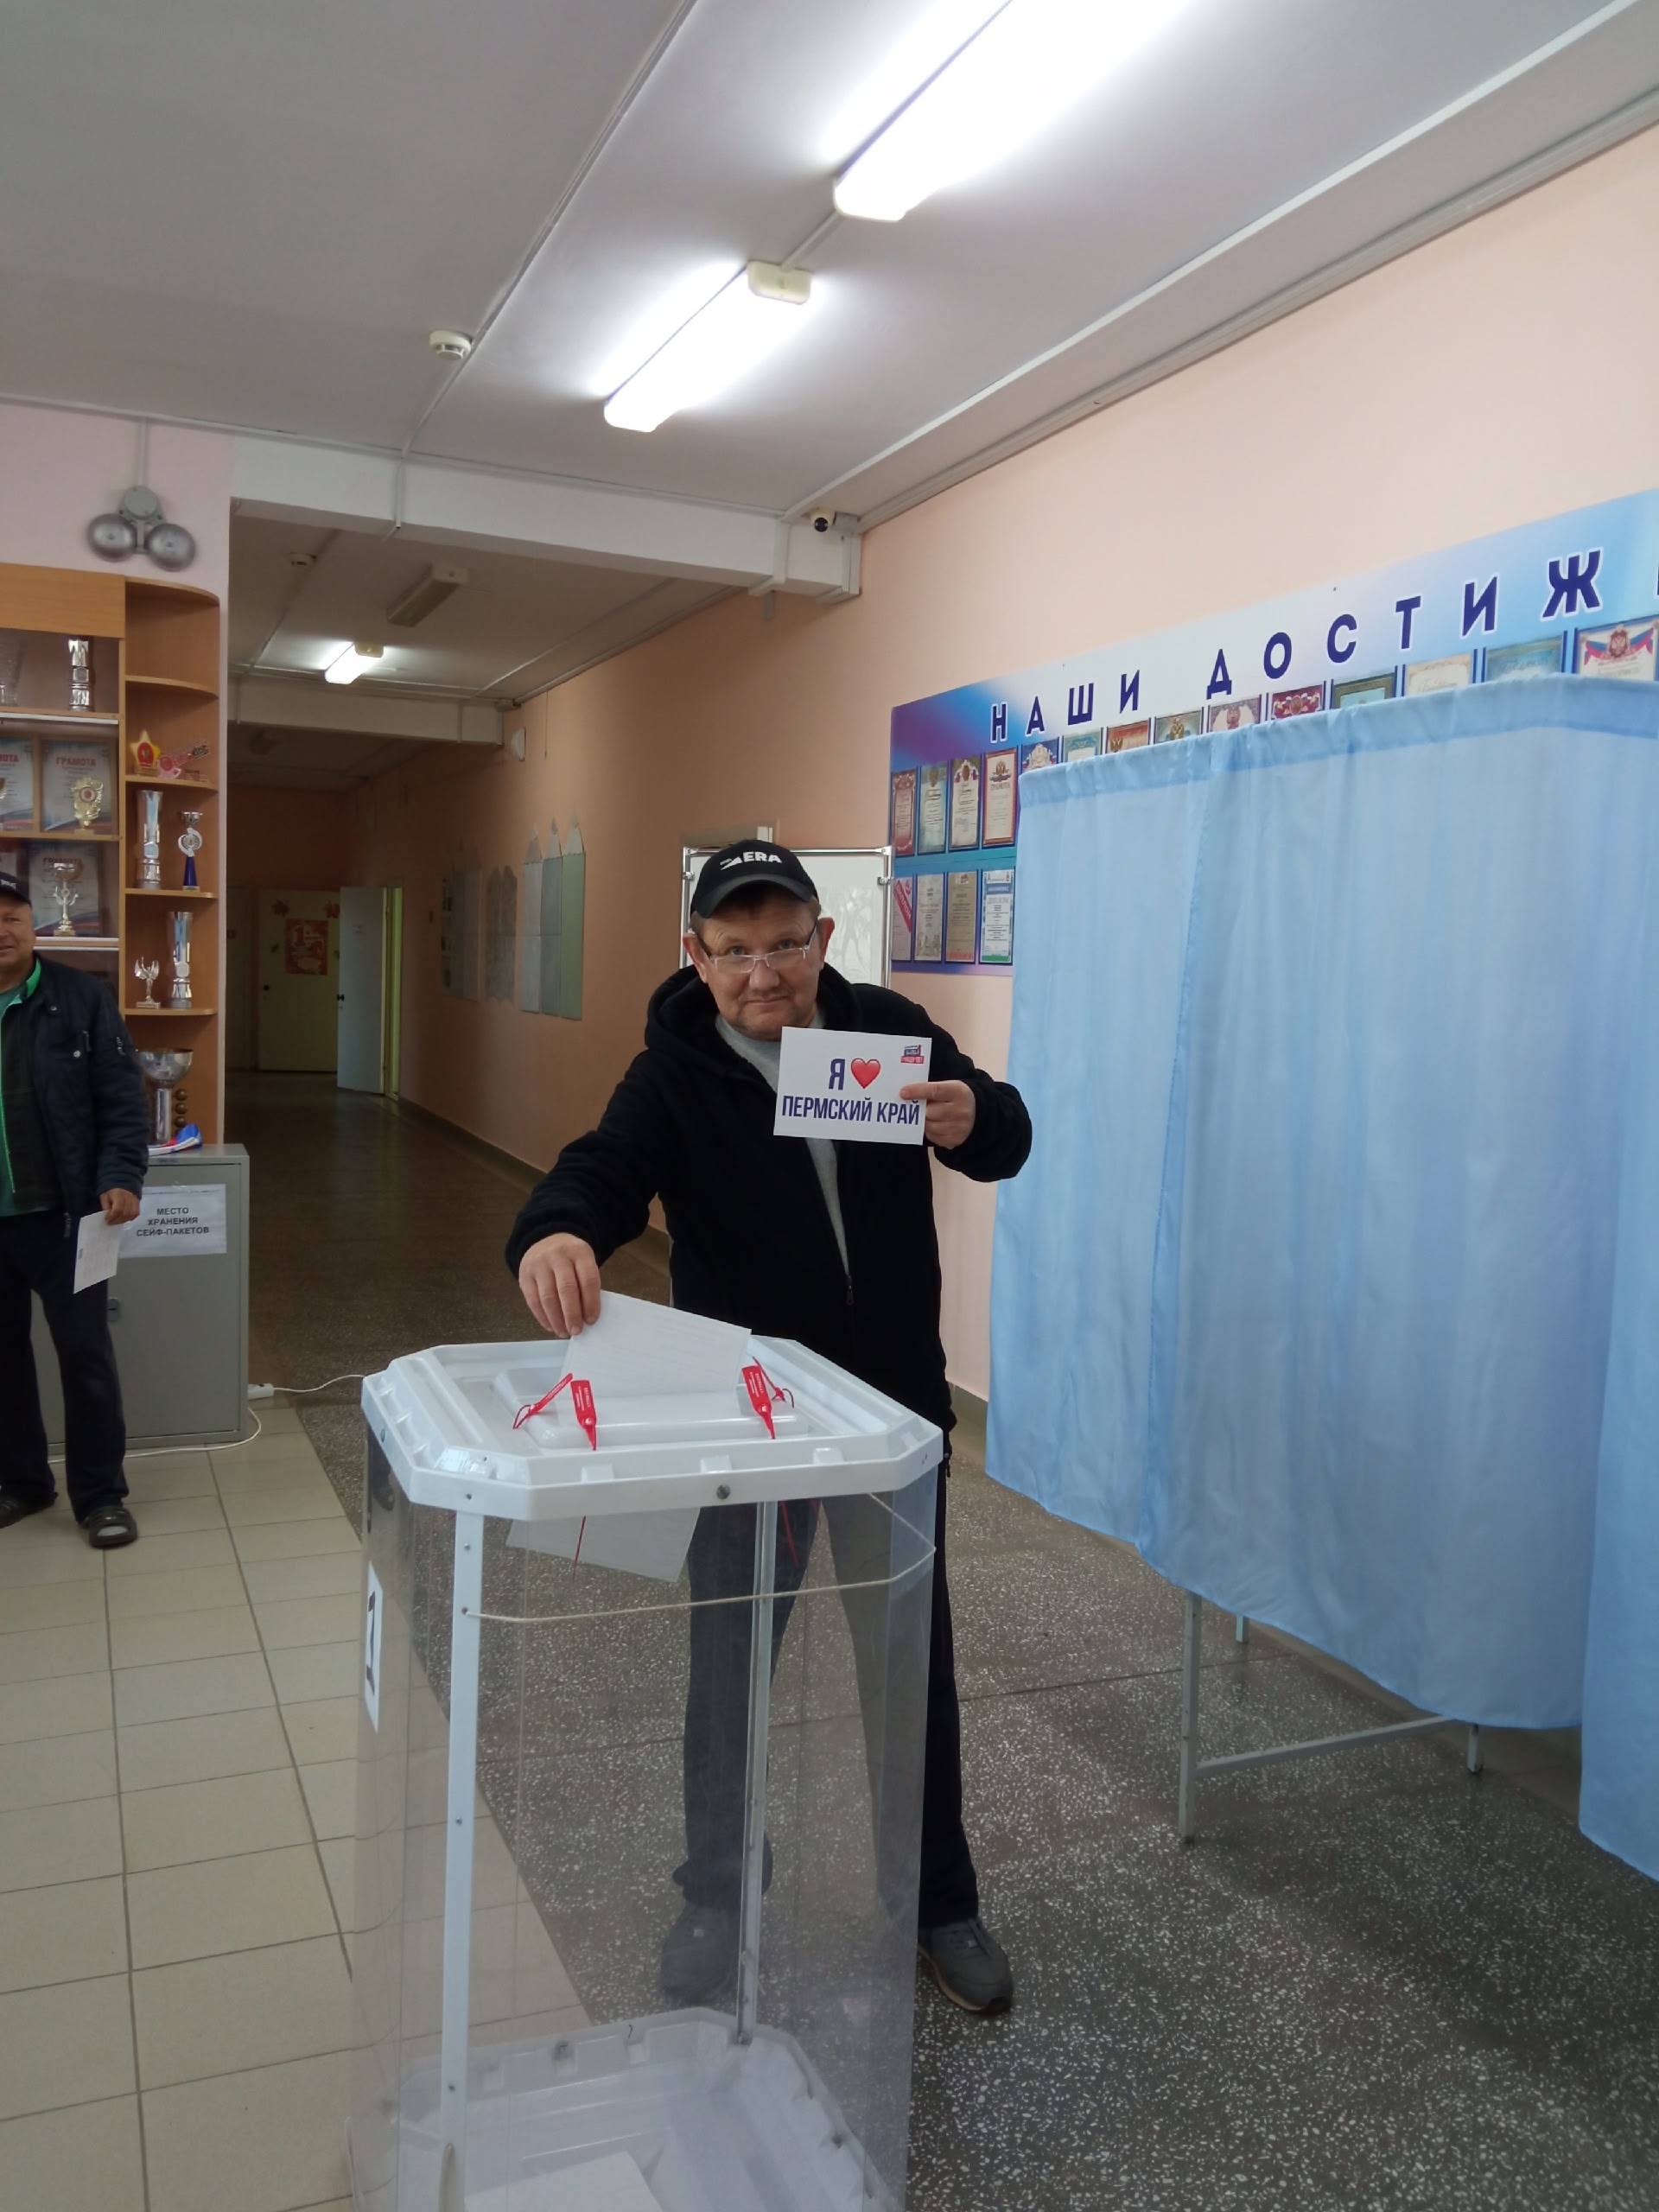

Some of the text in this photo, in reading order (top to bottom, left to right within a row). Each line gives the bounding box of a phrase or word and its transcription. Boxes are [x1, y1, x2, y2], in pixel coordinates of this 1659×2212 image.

[991, 549, 1659, 742] НАШИ ДОСТИЖ
[743, 851, 782, 863] ERA
[828, 1058, 846, 1090] Я
[781, 1095, 920, 1126] ПЕРМСКИЙ КРАЙ
[156, 1207, 189, 1216] МЕСТО
[148, 1217, 198, 1226] ХРАНЕНИЯ
[137, 1226, 209, 1237] СЕЙФ-ПАКЕТОВ
